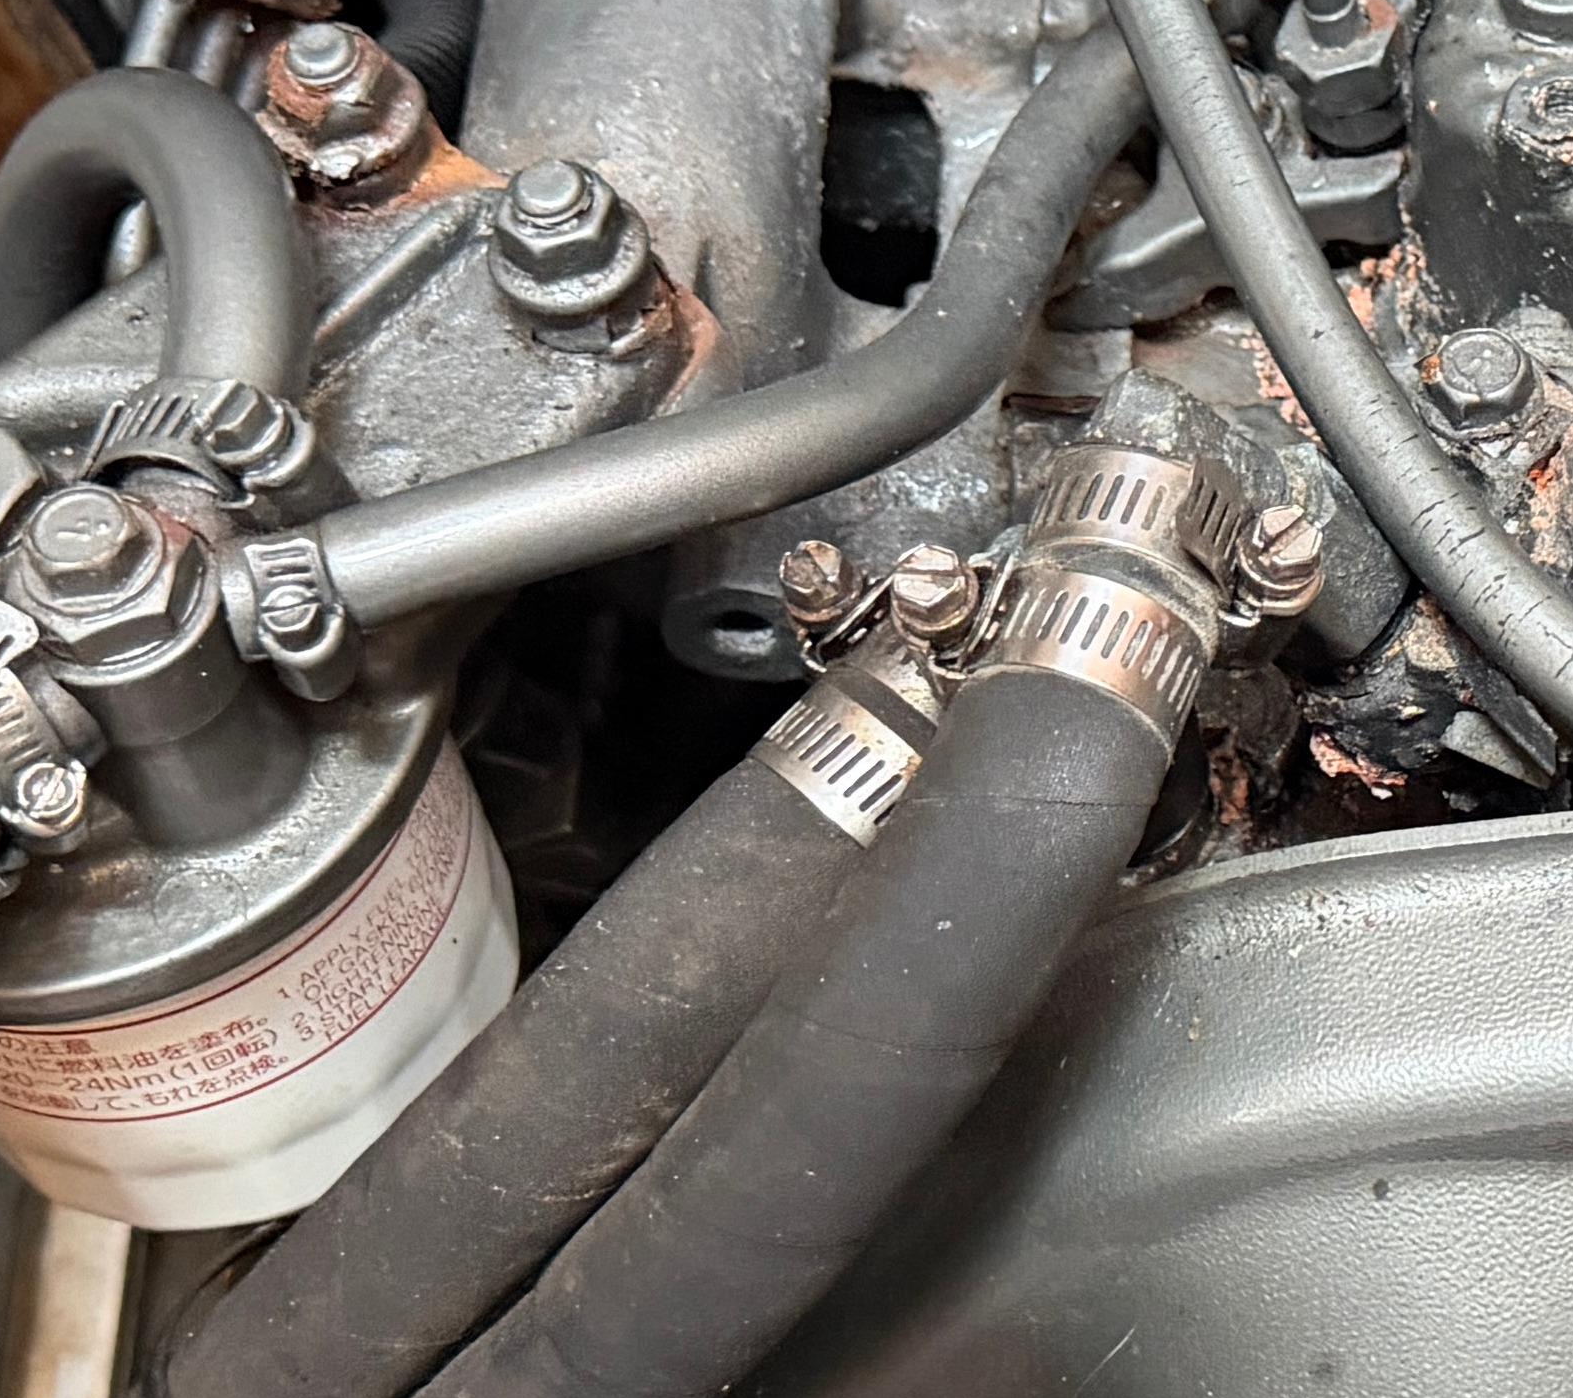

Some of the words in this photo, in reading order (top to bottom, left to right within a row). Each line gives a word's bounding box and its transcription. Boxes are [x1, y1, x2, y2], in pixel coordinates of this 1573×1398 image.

[300, 925, 362, 989] APPLY
[314, 901, 421, 1013] TIGHTENING
[337, 898, 411, 977] GASKET
[319, 971, 384, 1030] START
[325, 1000, 378, 1044] FUEL
